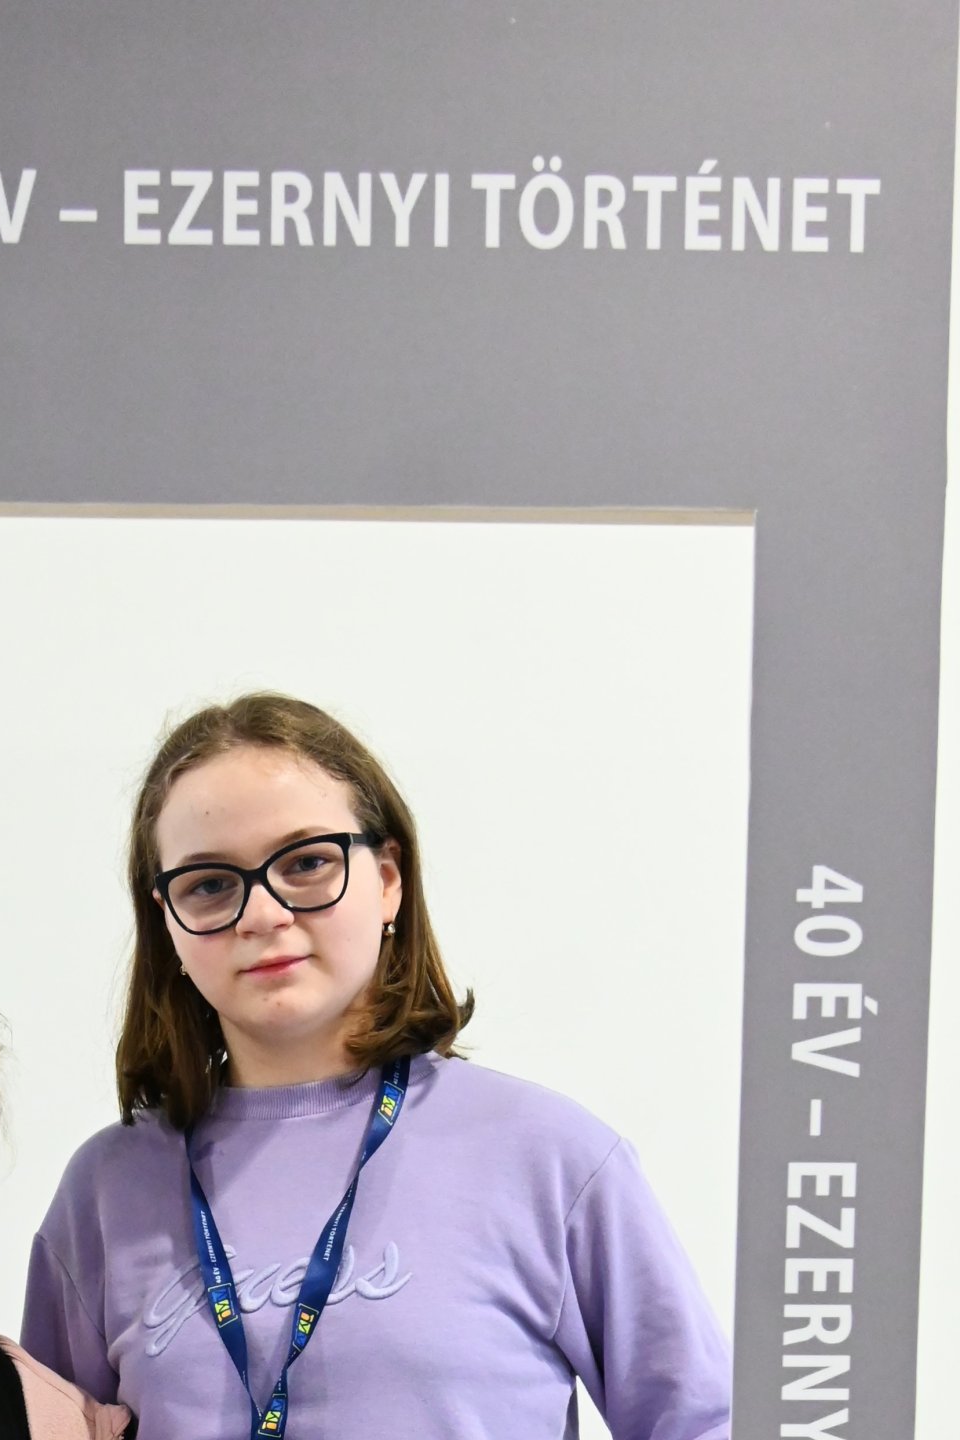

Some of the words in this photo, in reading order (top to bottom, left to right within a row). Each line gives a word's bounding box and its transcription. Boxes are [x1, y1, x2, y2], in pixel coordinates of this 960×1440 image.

[124, 170, 449, 249] EZERNYI
[471, 155, 881, 254] TÖRTÉNET
[794, 865, 864, 957] 40
[790, 982, 879, 1078] ÉV
